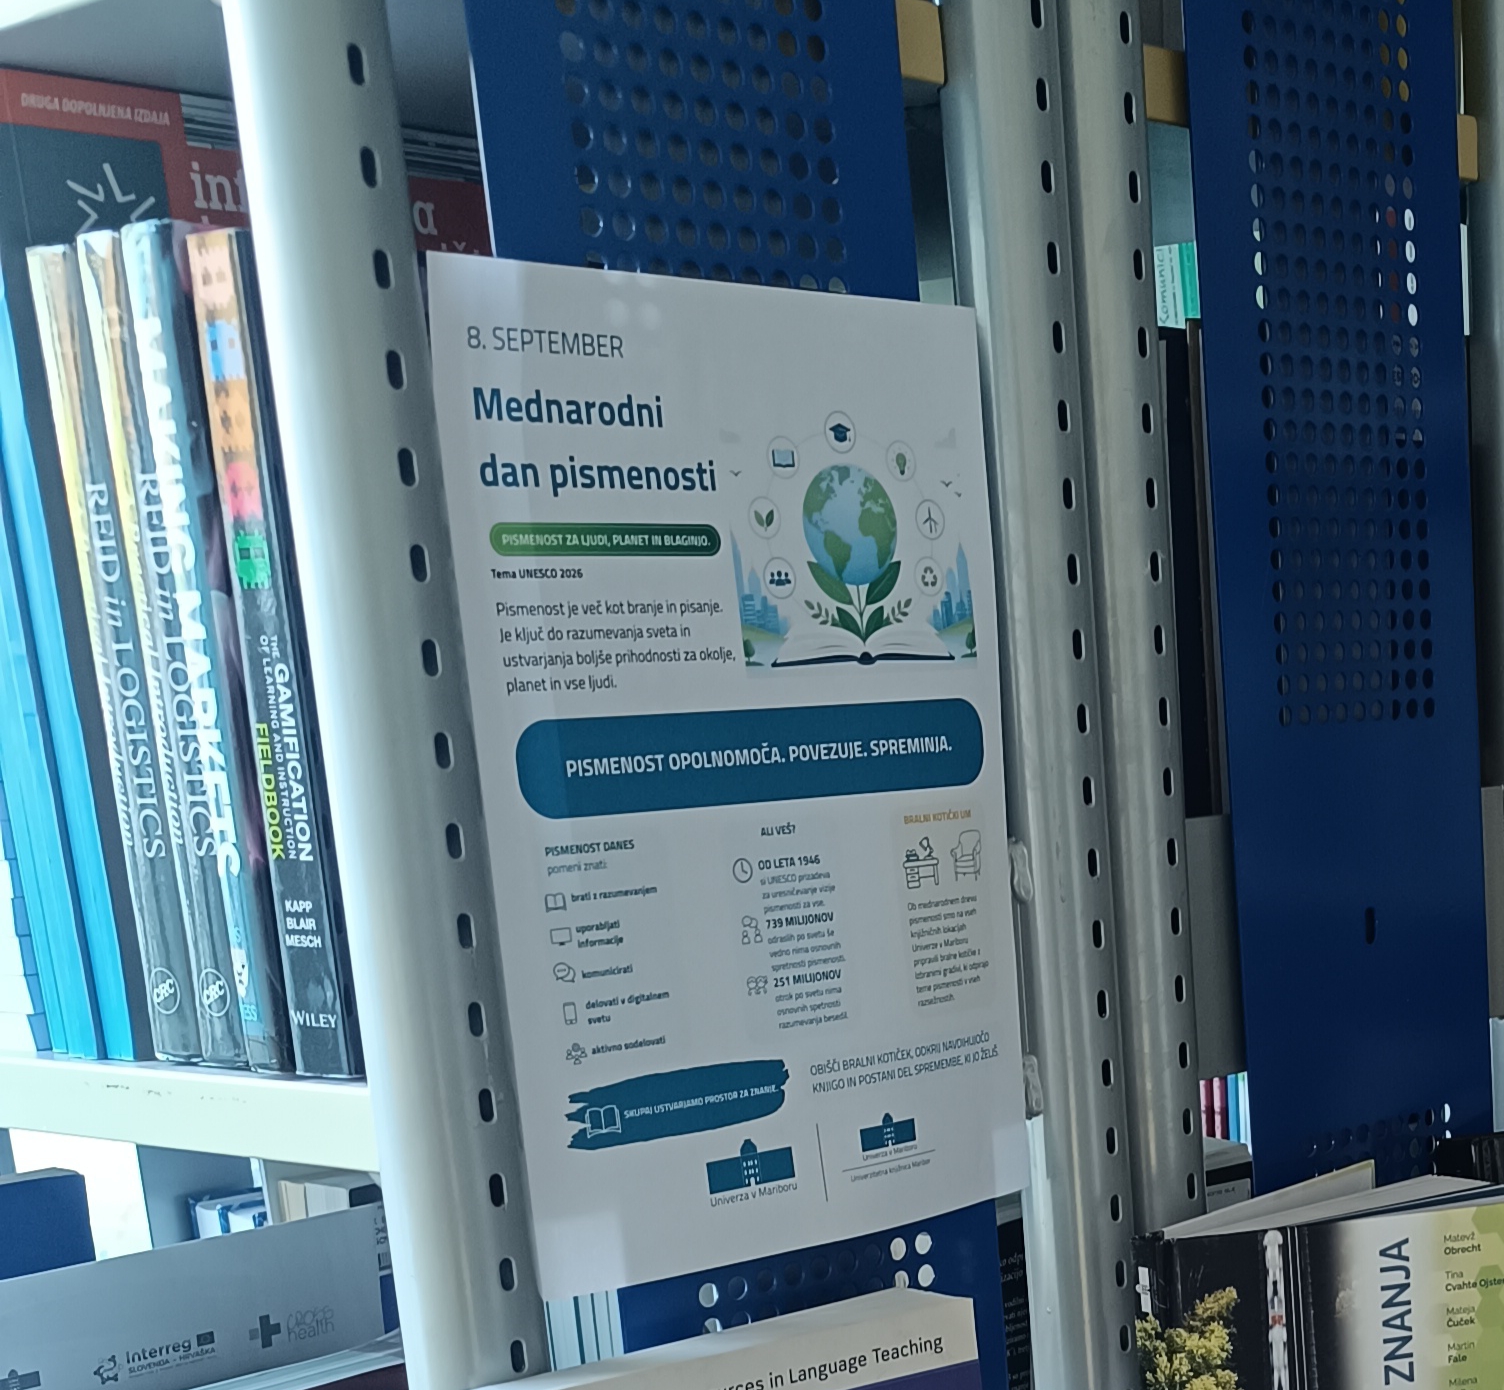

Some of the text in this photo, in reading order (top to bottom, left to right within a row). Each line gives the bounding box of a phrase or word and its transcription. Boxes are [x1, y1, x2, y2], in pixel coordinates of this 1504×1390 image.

[467, 325, 624, 358] 8. SEPTEMBER
[472, 387, 664, 428] Mednarodni
[480, 454, 717, 497] dan pismenosti
[491, 568, 583, 579] Tema UNESCO 2026
[496, 599, 723, 618] Pismenost je več kot branje in pisanje.
[500, 625, 690, 643] Je ključ do razumevanja sveta in
[506, 674, 617, 695] planet in vse ljudi.
[273, 663, 314, 862] GAMIFICATION
[566, 736, 953, 777] PISMENOST OPOLNOMOČA. POVEZUJE. SPREMINJA.
[256, 723, 285, 860] FIELDBOOK
[758, 855, 820, 870] OD LETA 1946
[285, 901, 313, 914] KAPP
[286, 917, 316, 931] BLAIR
[766, 912, 834, 928] 739 MILIJONOV
[286, 934, 322, 948] MESCH
[773, 969, 841, 987] 251 MILIJONOV
[292, 1009, 338, 1029] WILEY
[1380, 1238, 1415, 1387] ZNANJA
[769, 1372, 784, 1388] in
[788, 1354, 867, 1387] Language
[872, 1334, 944, 1365] Teaching
